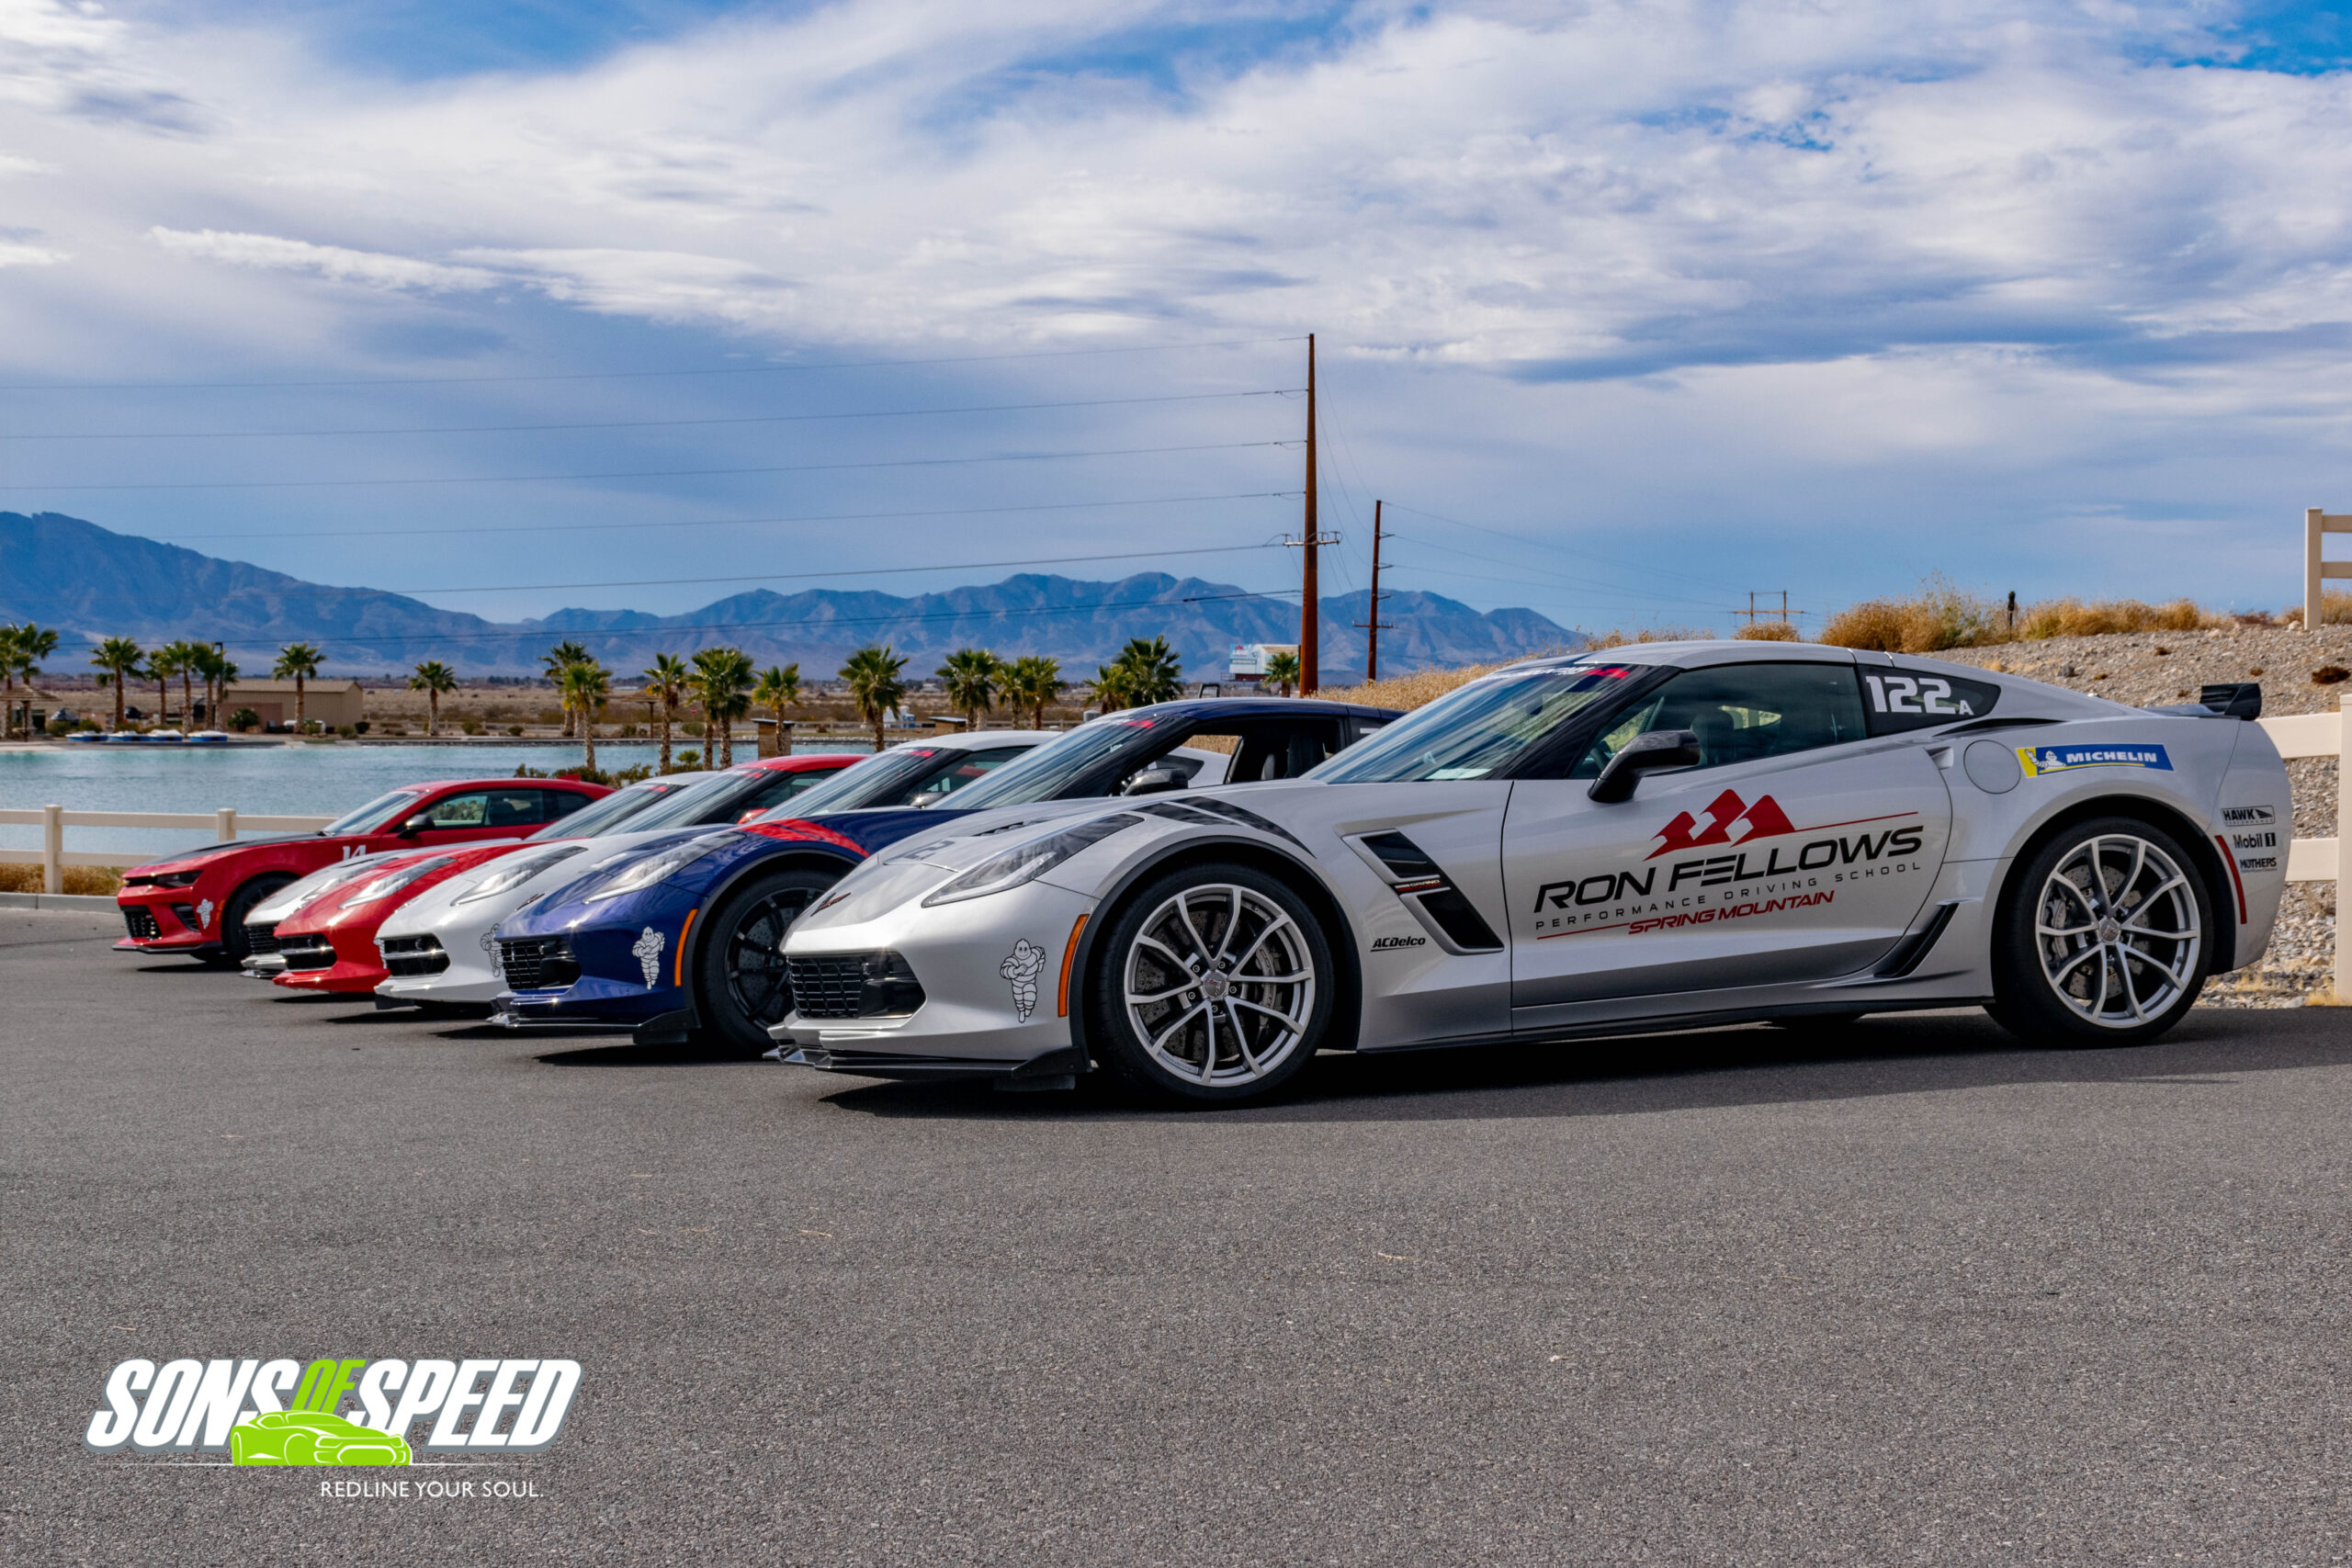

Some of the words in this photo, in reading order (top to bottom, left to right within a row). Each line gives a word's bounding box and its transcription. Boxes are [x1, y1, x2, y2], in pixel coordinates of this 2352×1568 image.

[2066, 751, 2158, 763] MICHELIN
[2223, 809, 2256, 820] HAWK
[2233, 832, 2263, 849] Mobil
[2265, 832, 2276, 847] 1
[1533, 867, 1657, 913] RON
[1668, 826, 1924, 892] FELLOWS
[2239, 857, 2278, 869] MOTHERS
[1536, 896, 1706, 930] PERFORMANCE
[1724, 878, 1817, 900] DRIVING
[1835, 863, 1921, 883] SCHOOL
[1628, 908, 1716, 935] SPRING
[1718, 890, 1835, 920] MOUNTAIN
[1373, 936, 1426, 948] ACDelco
